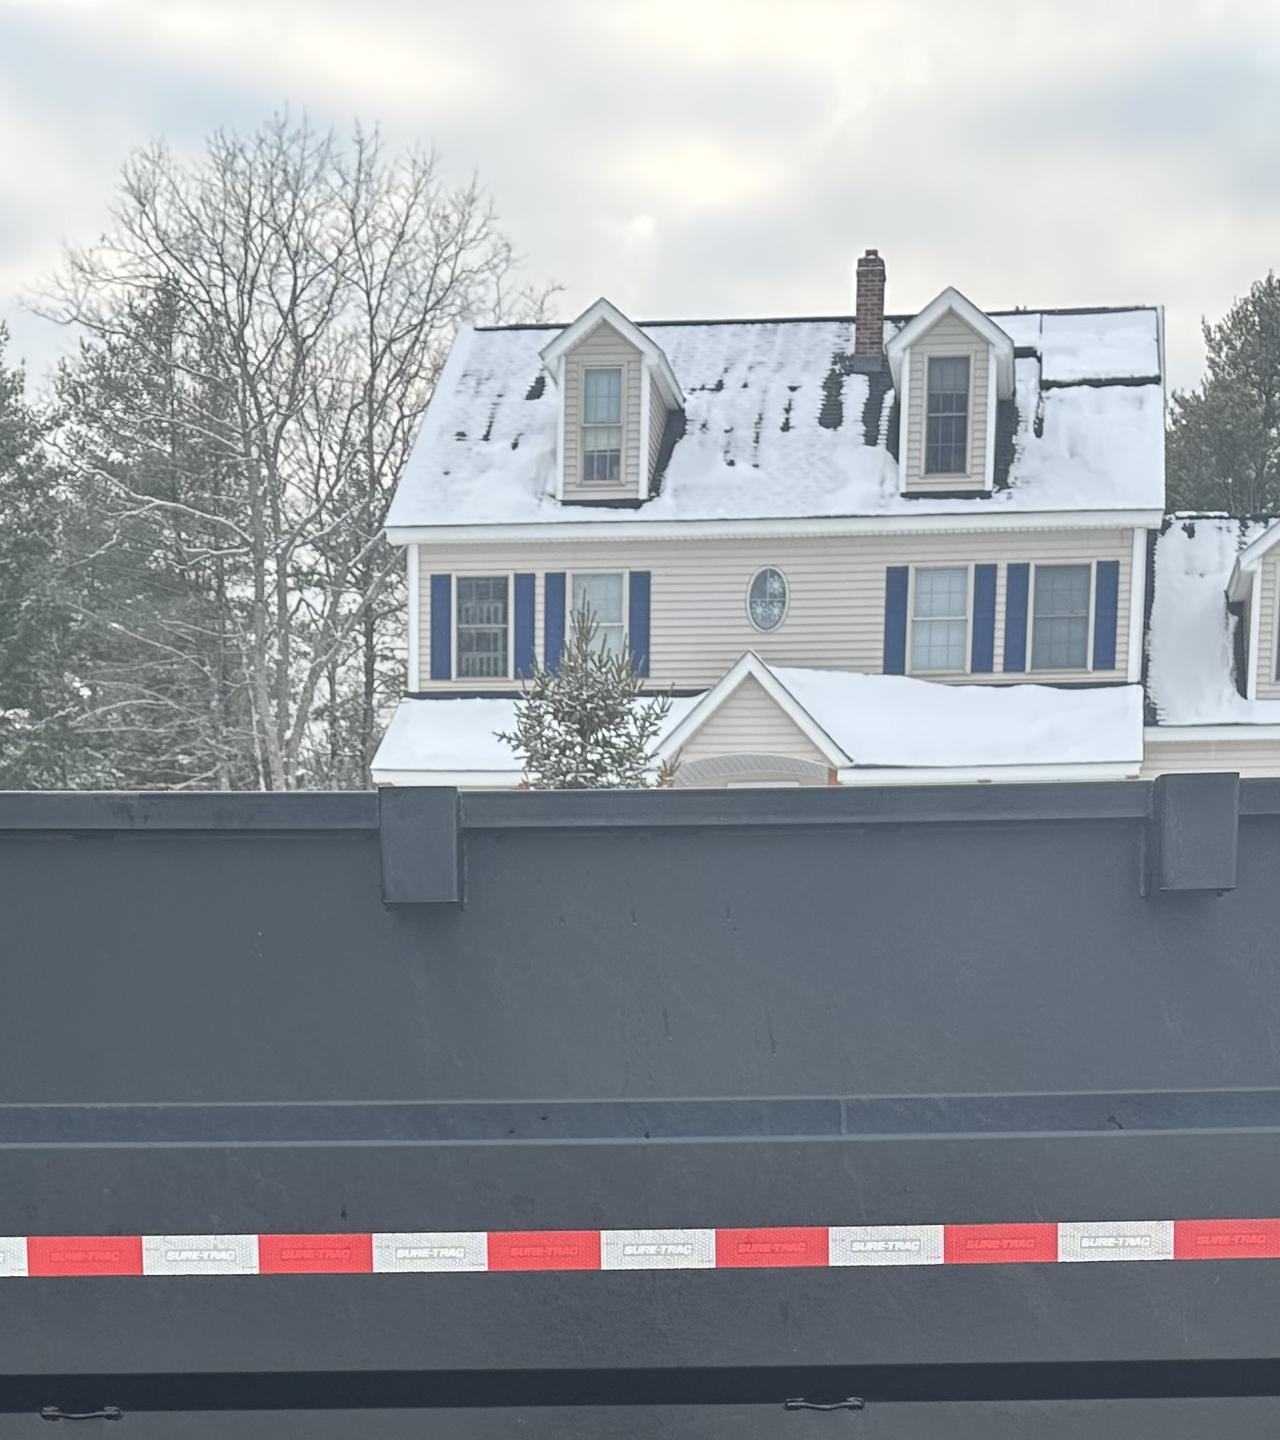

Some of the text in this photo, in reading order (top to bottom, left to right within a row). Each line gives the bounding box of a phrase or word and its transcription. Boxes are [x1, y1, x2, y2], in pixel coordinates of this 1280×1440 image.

[852, 1240, 920, 1251] SURE-TRAC
[1081, 1237, 1150, 1248] SURE-TRAC
[396, 1247, 465, 1258] SURE-TRAC
[624, 1244, 692, 1255] SURE-TRAC
[166, 1250, 235, 1261] SURE-TRAC
